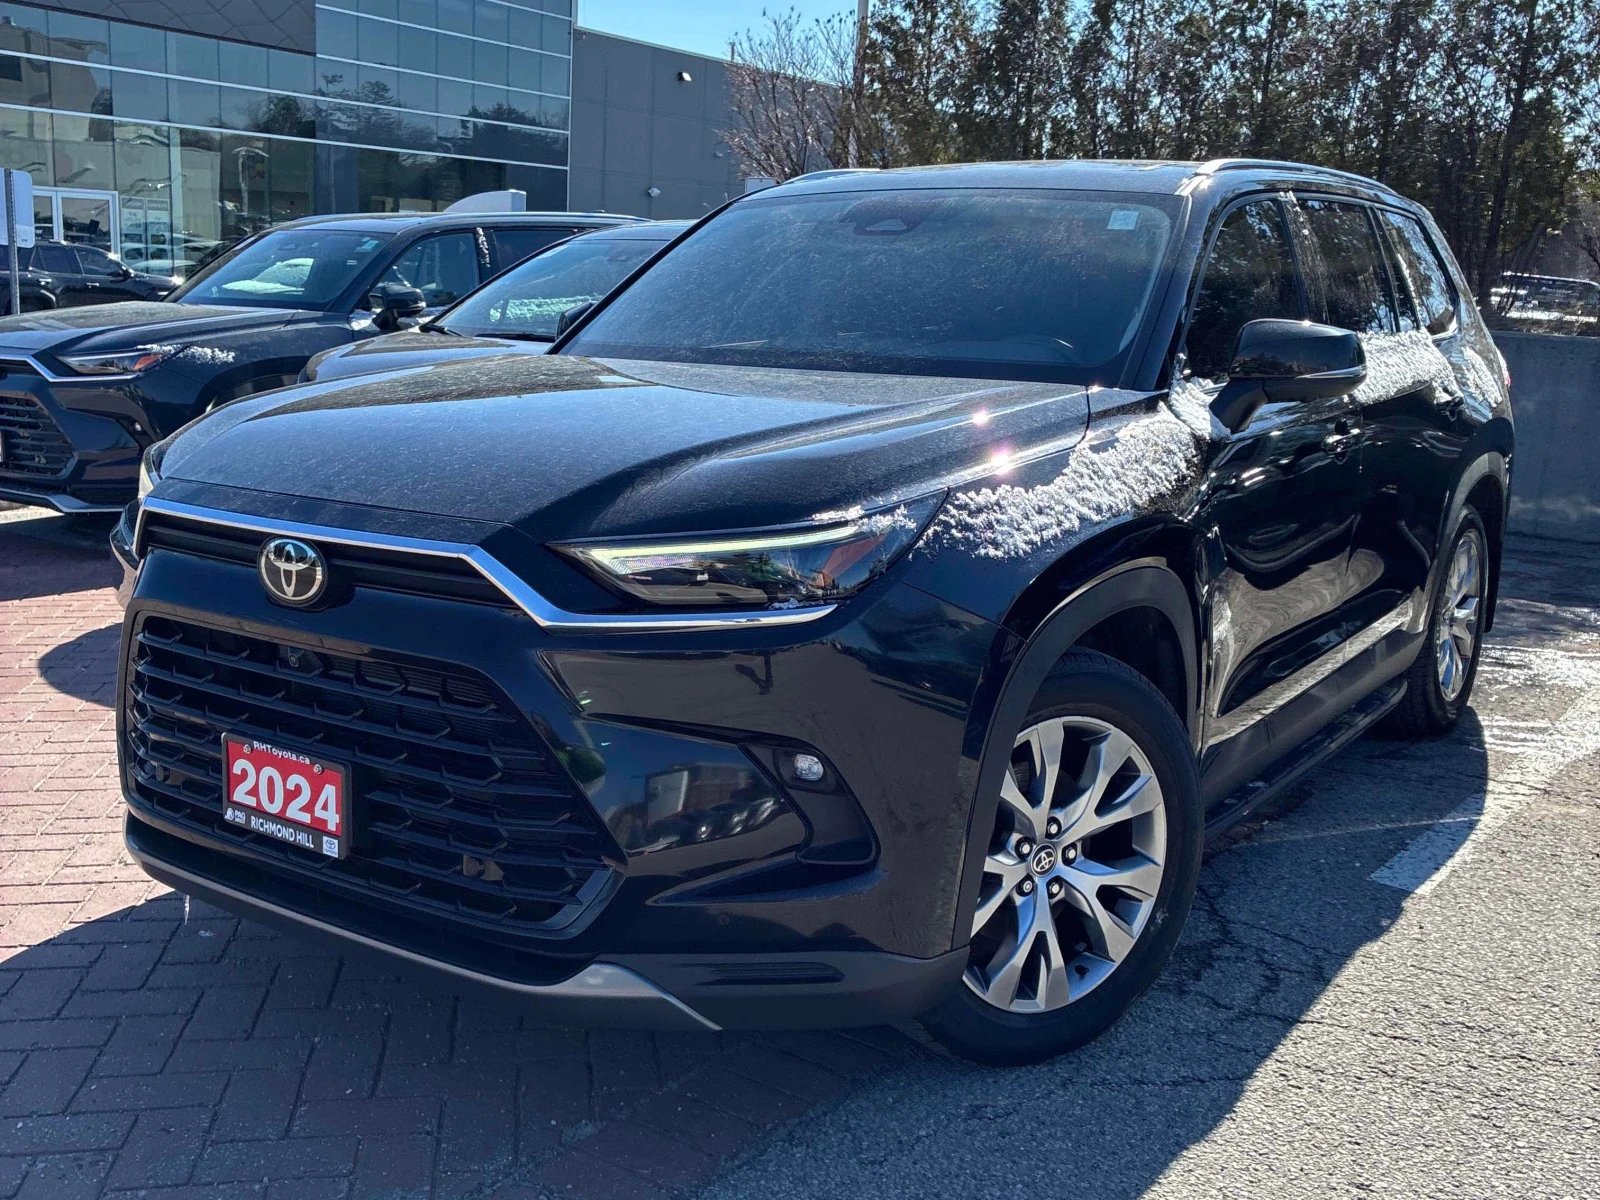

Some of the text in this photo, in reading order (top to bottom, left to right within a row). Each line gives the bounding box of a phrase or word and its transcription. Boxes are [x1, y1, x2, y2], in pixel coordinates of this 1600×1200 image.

[253, 740, 311, 766] RHToyota.ca
[232, 758, 340, 832] 2024
[250, 815, 315, 849] RICHMOND HILL
